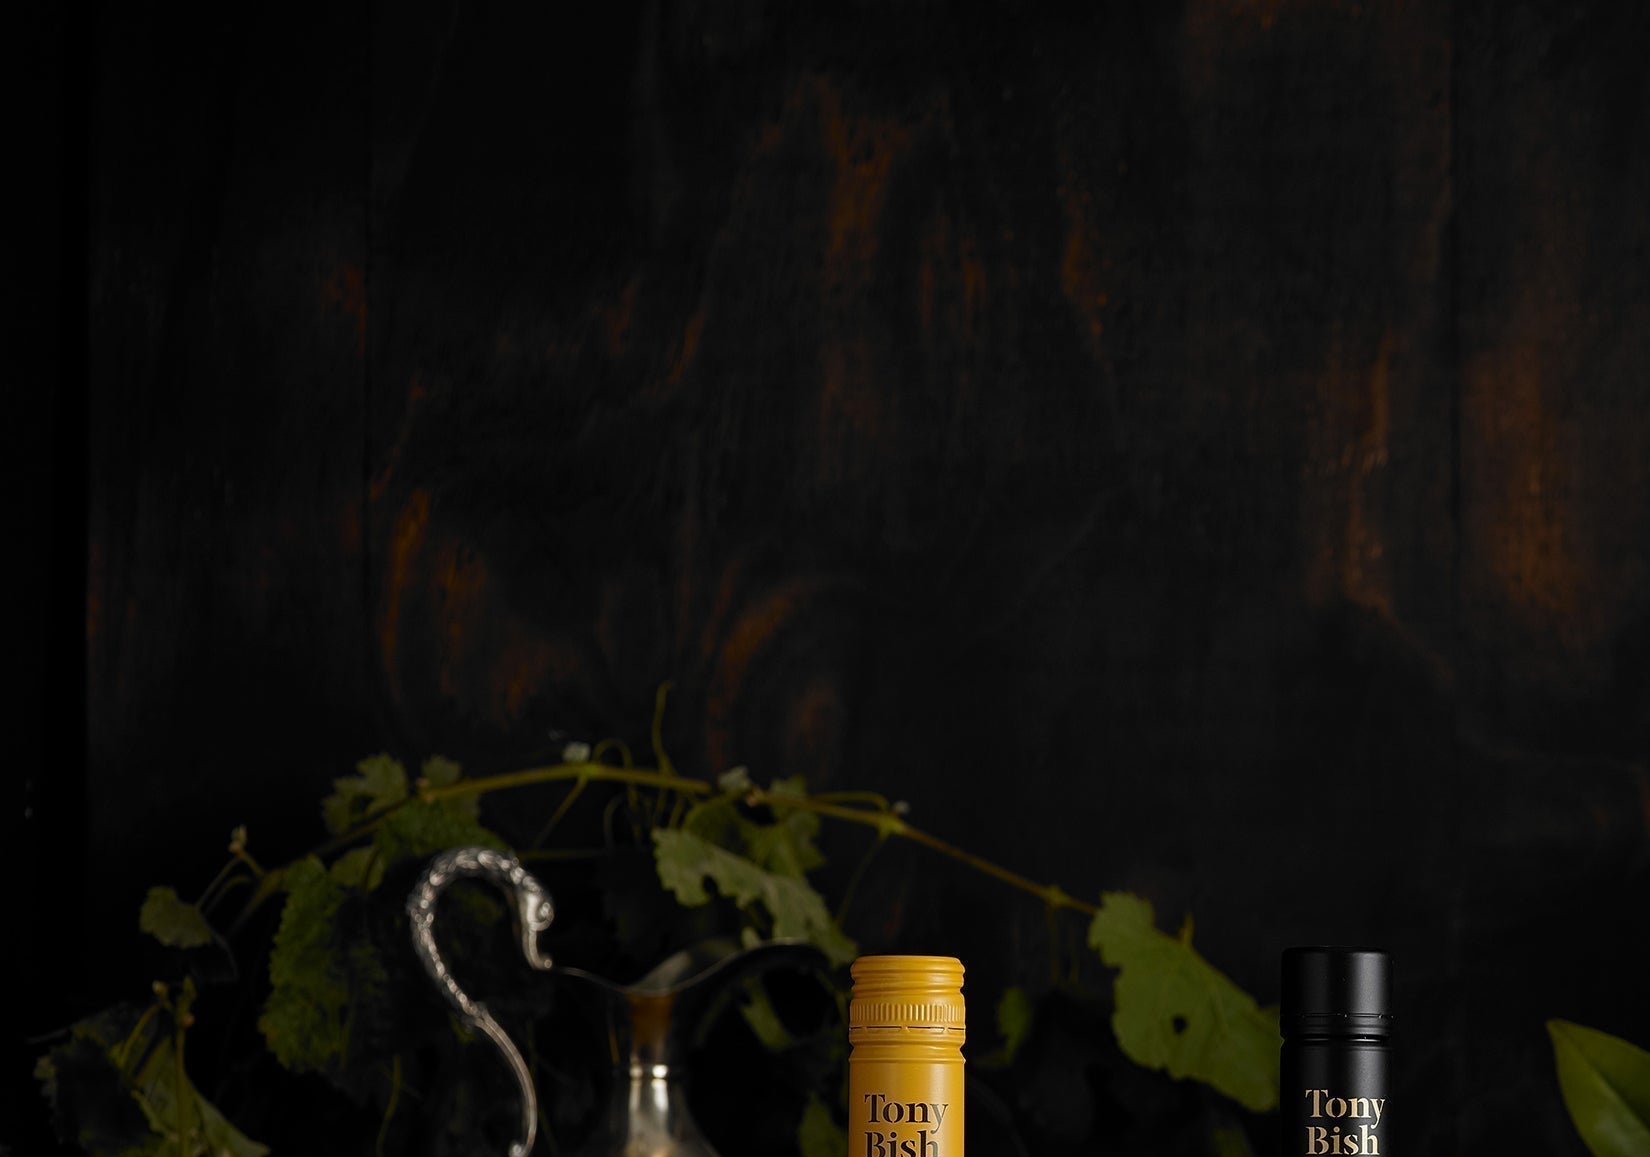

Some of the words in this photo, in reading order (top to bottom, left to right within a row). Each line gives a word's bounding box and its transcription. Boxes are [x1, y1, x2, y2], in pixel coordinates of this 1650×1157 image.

[864, 1094, 949, 1134] Tony
[1305, 1088, 1386, 1129] Tony
[1305, 1124, 1380, 1156] Bish
